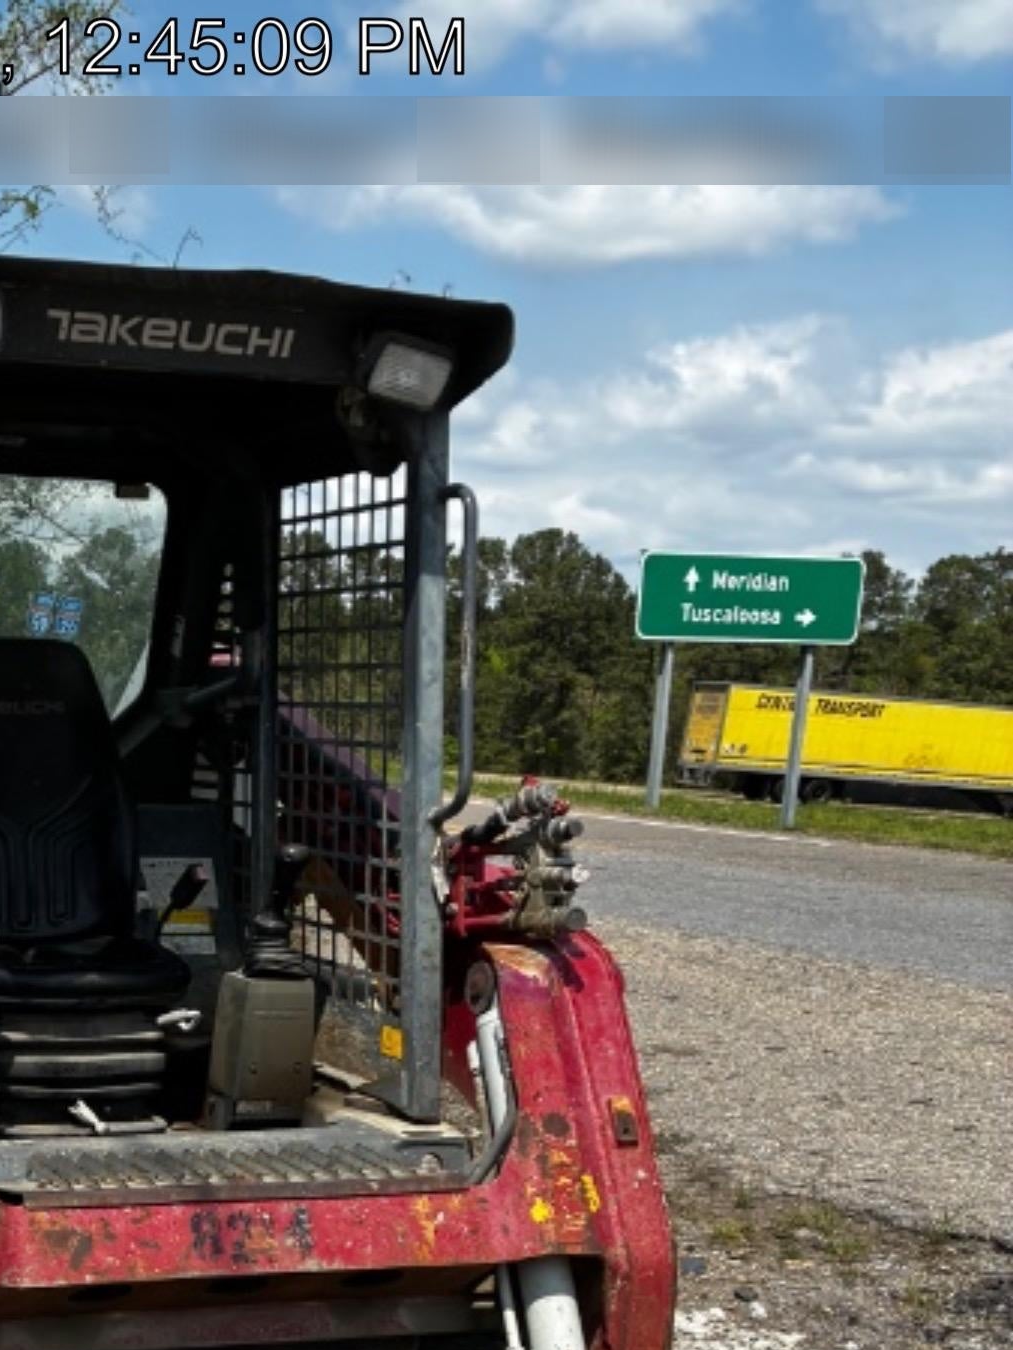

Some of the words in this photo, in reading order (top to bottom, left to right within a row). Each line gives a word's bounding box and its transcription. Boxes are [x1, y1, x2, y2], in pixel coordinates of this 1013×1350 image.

[712, 569, 790, 592] Meridian
[681, 602, 781, 625] Tuscaloosa
[815, 698, 886, 719] TRANSPORT
